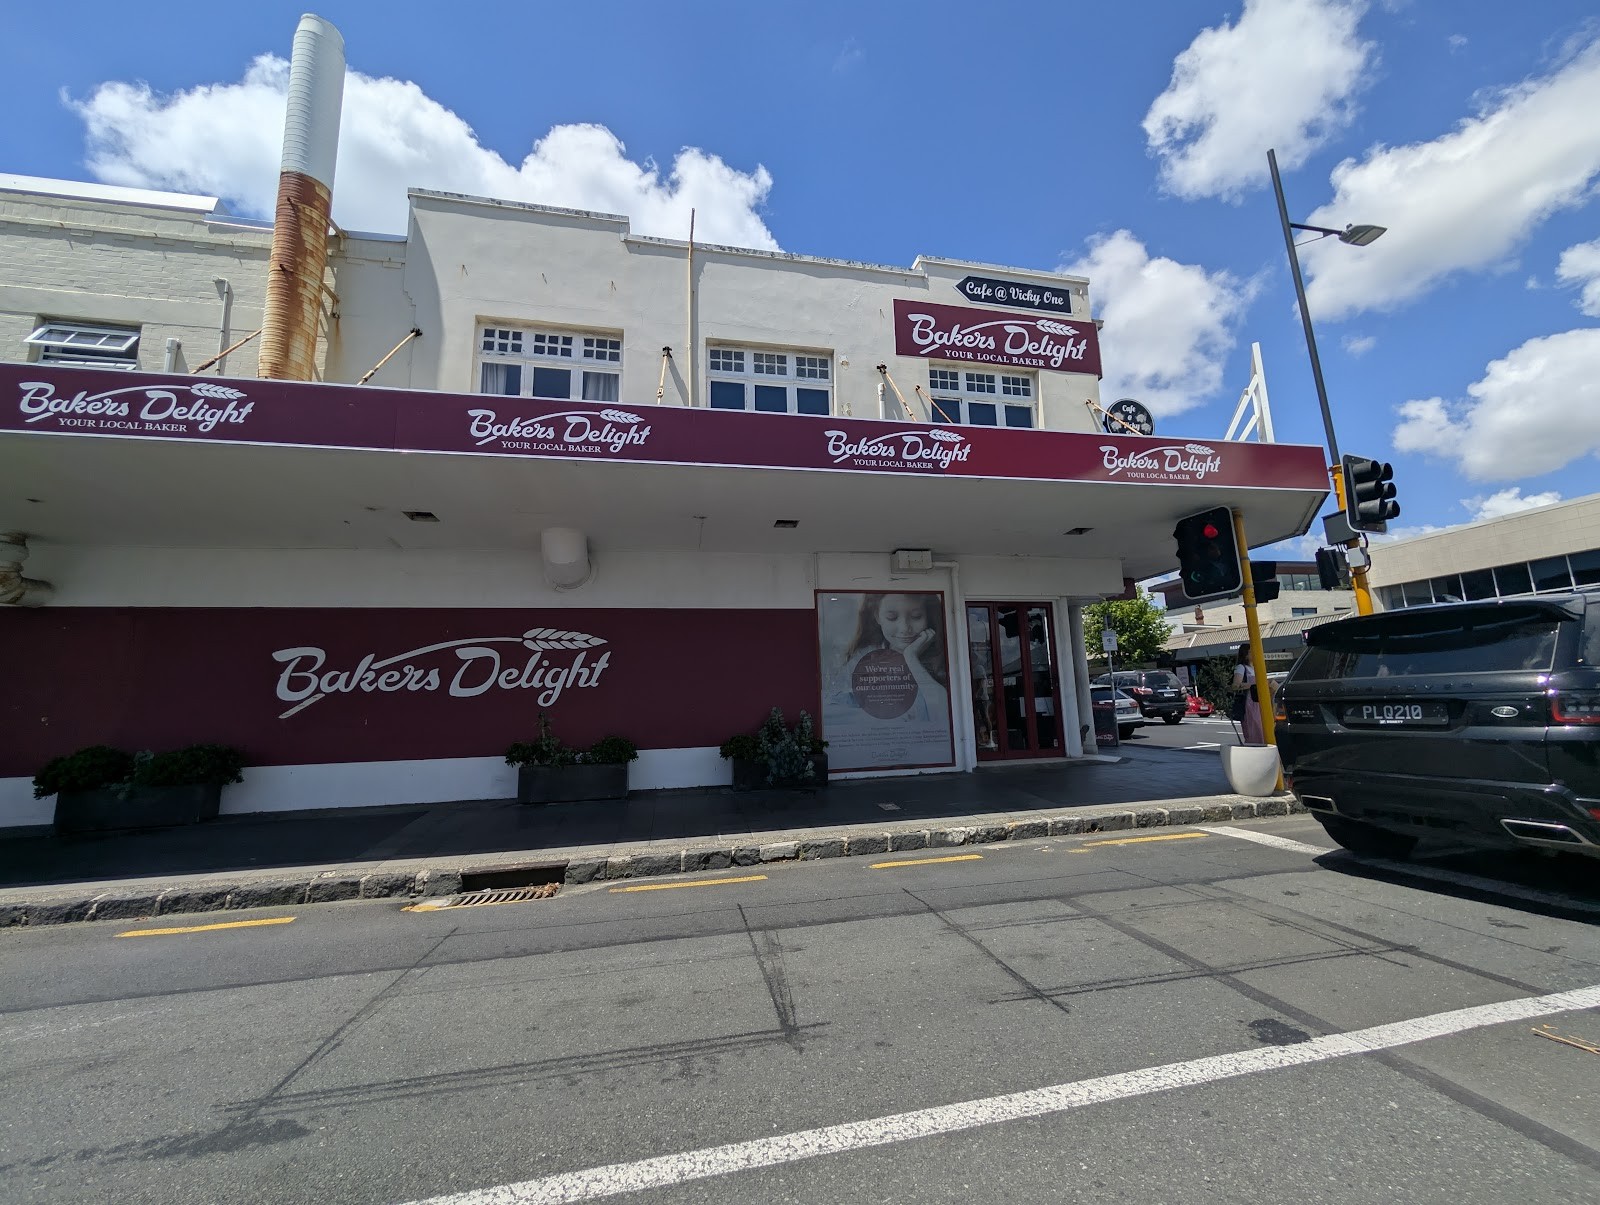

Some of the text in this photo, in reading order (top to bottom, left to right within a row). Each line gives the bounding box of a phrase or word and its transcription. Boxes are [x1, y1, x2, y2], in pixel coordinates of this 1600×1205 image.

[965, 281, 1064, 306] Cafe @ Vicky One
[907, 313, 1087, 368] Bakers Delight
[944, 350, 1046, 367] YOUR LOCAL BAKER
[19, 381, 255, 432] Bakers Delight
[58, 417, 188, 432] YOUR LOCAL BAKER
[467, 409, 652, 453] Bakers Delight
[501, 440, 602, 453] YOUR LOCAL BAKER
[824, 430, 972, 469] Bakers Delight
[853, 458, 934, 469] YOUR LOCAL BAKER
[1099, 445, 1221, 479] Bakers Delight
[1146, 472, 1168, 480] LOCAL
[272, 646, 612, 707] Bakers Delight
[864, 664, 905, 673] We're real
[859, 673, 912, 683] supporters of
[871, 682, 915, 691] community
[1362, 705, 1423, 720] PLQ210
